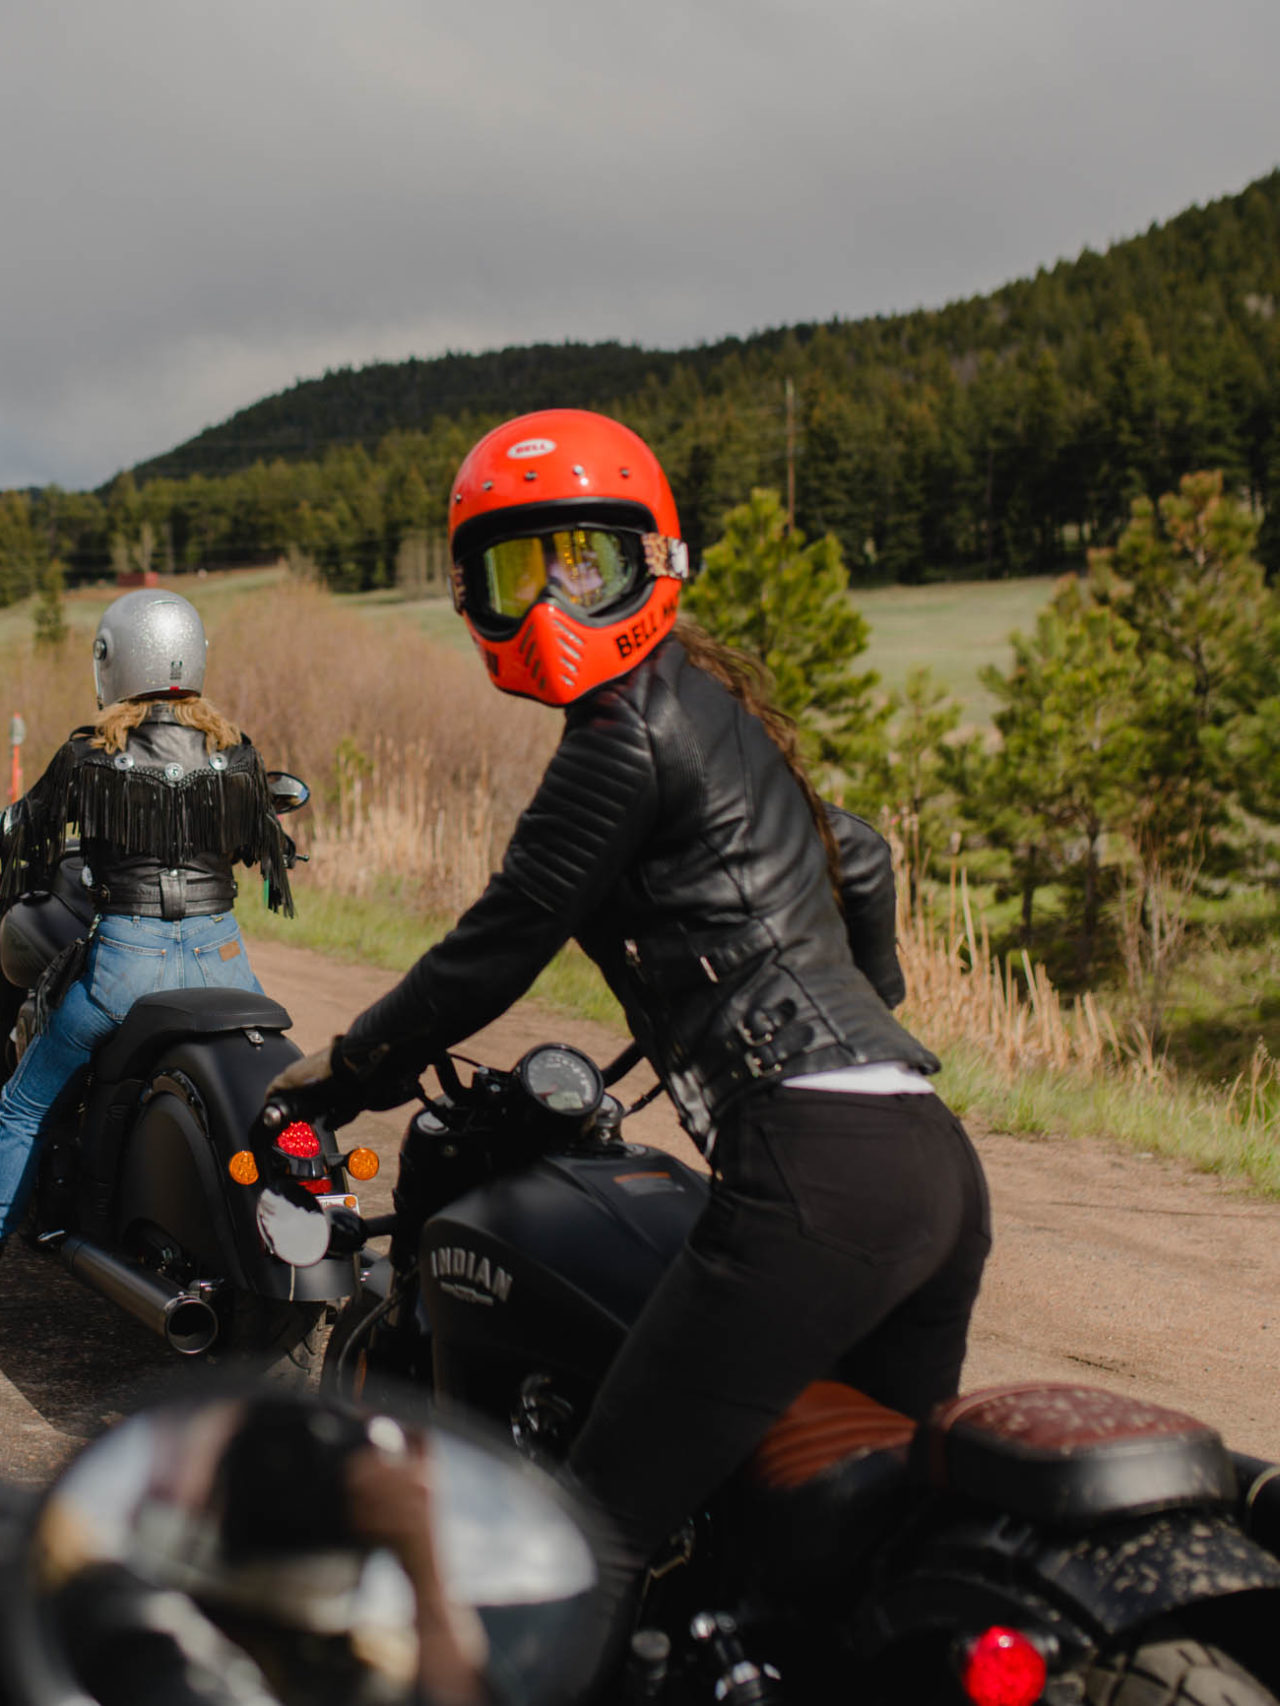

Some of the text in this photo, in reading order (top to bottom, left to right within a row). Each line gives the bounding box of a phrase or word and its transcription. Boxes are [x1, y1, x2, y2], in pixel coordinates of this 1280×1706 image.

[515, 443, 546, 454] BELL
[616, 610, 658, 658] BELL
[431, 1247, 513, 1302] INDIAN
